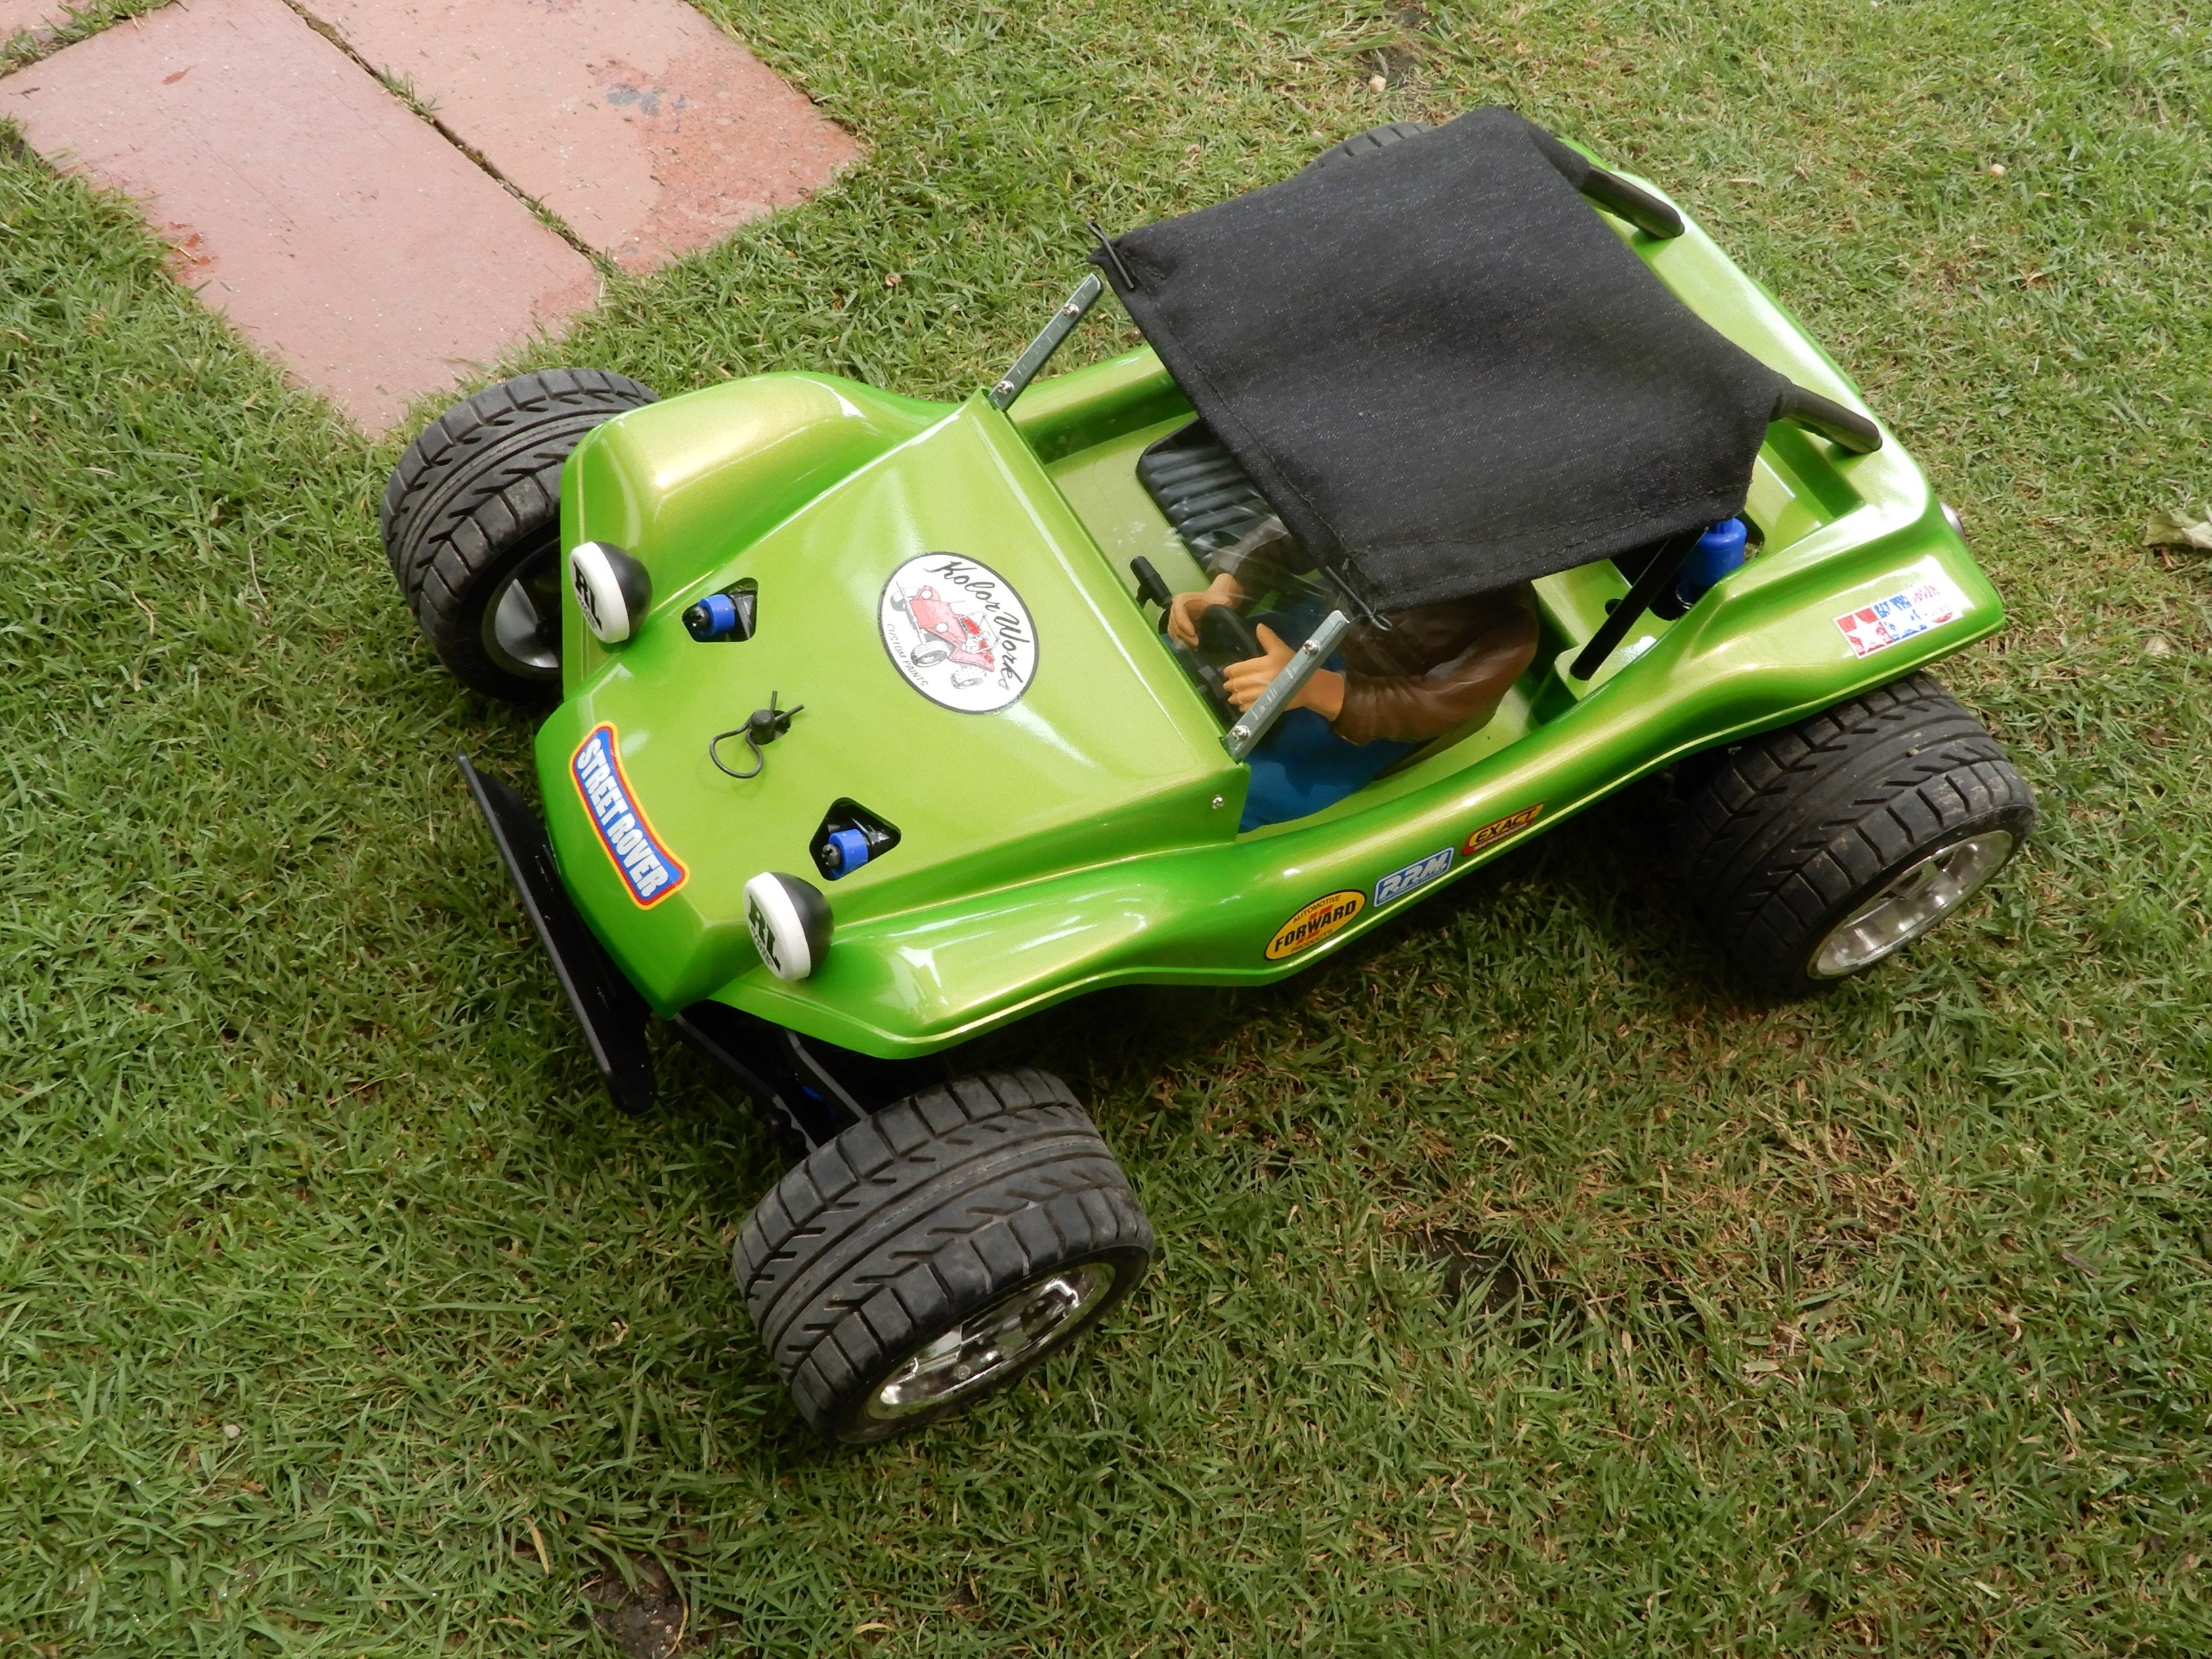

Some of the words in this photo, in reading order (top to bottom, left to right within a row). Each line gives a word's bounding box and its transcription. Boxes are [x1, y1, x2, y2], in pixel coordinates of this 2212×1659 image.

[887, 623, 906, 660] CUSTOM
[903, 660, 929, 686] PAINTS
[577, 738, 629, 826] STREET
[606, 812, 670, 897] ROVER
[1474, 808, 1537, 843] EXACT
[1274, 899, 1357, 953] FORWARD
[1292, 894, 1341, 923] AUTOMOTIVE
